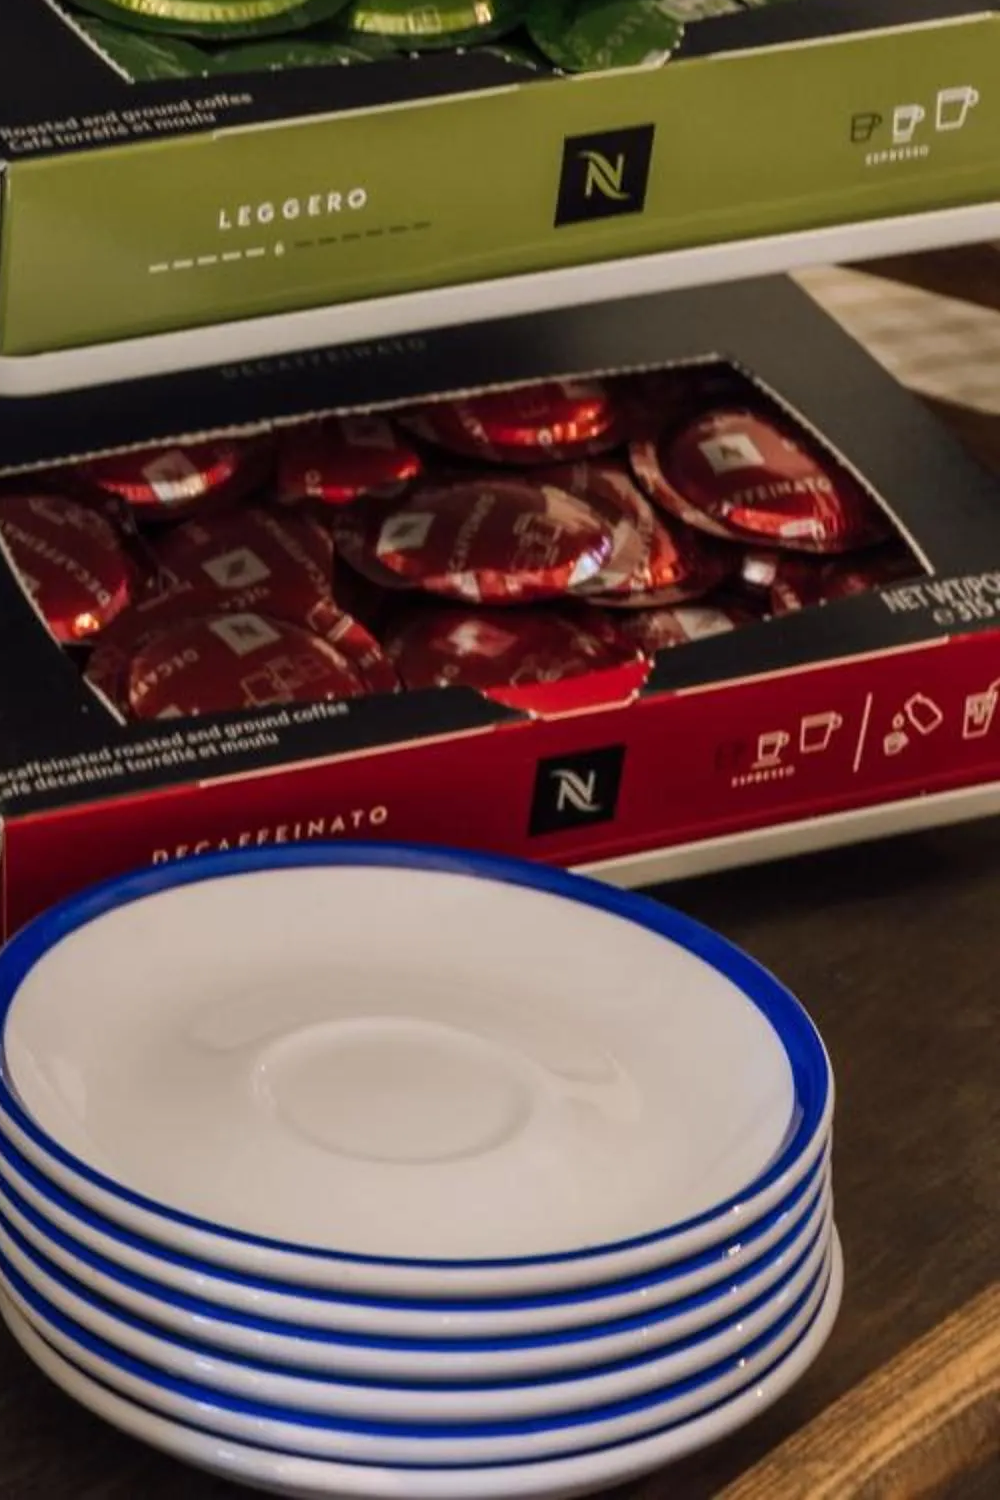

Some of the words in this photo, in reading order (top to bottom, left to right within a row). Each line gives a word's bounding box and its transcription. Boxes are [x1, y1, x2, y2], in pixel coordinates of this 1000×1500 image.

[218, 187, 368, 230] LEGGERO
[880, 584, 930, 615] NET
[186, 723, 222, 744] and
[223, 709, 291, 739] ground
